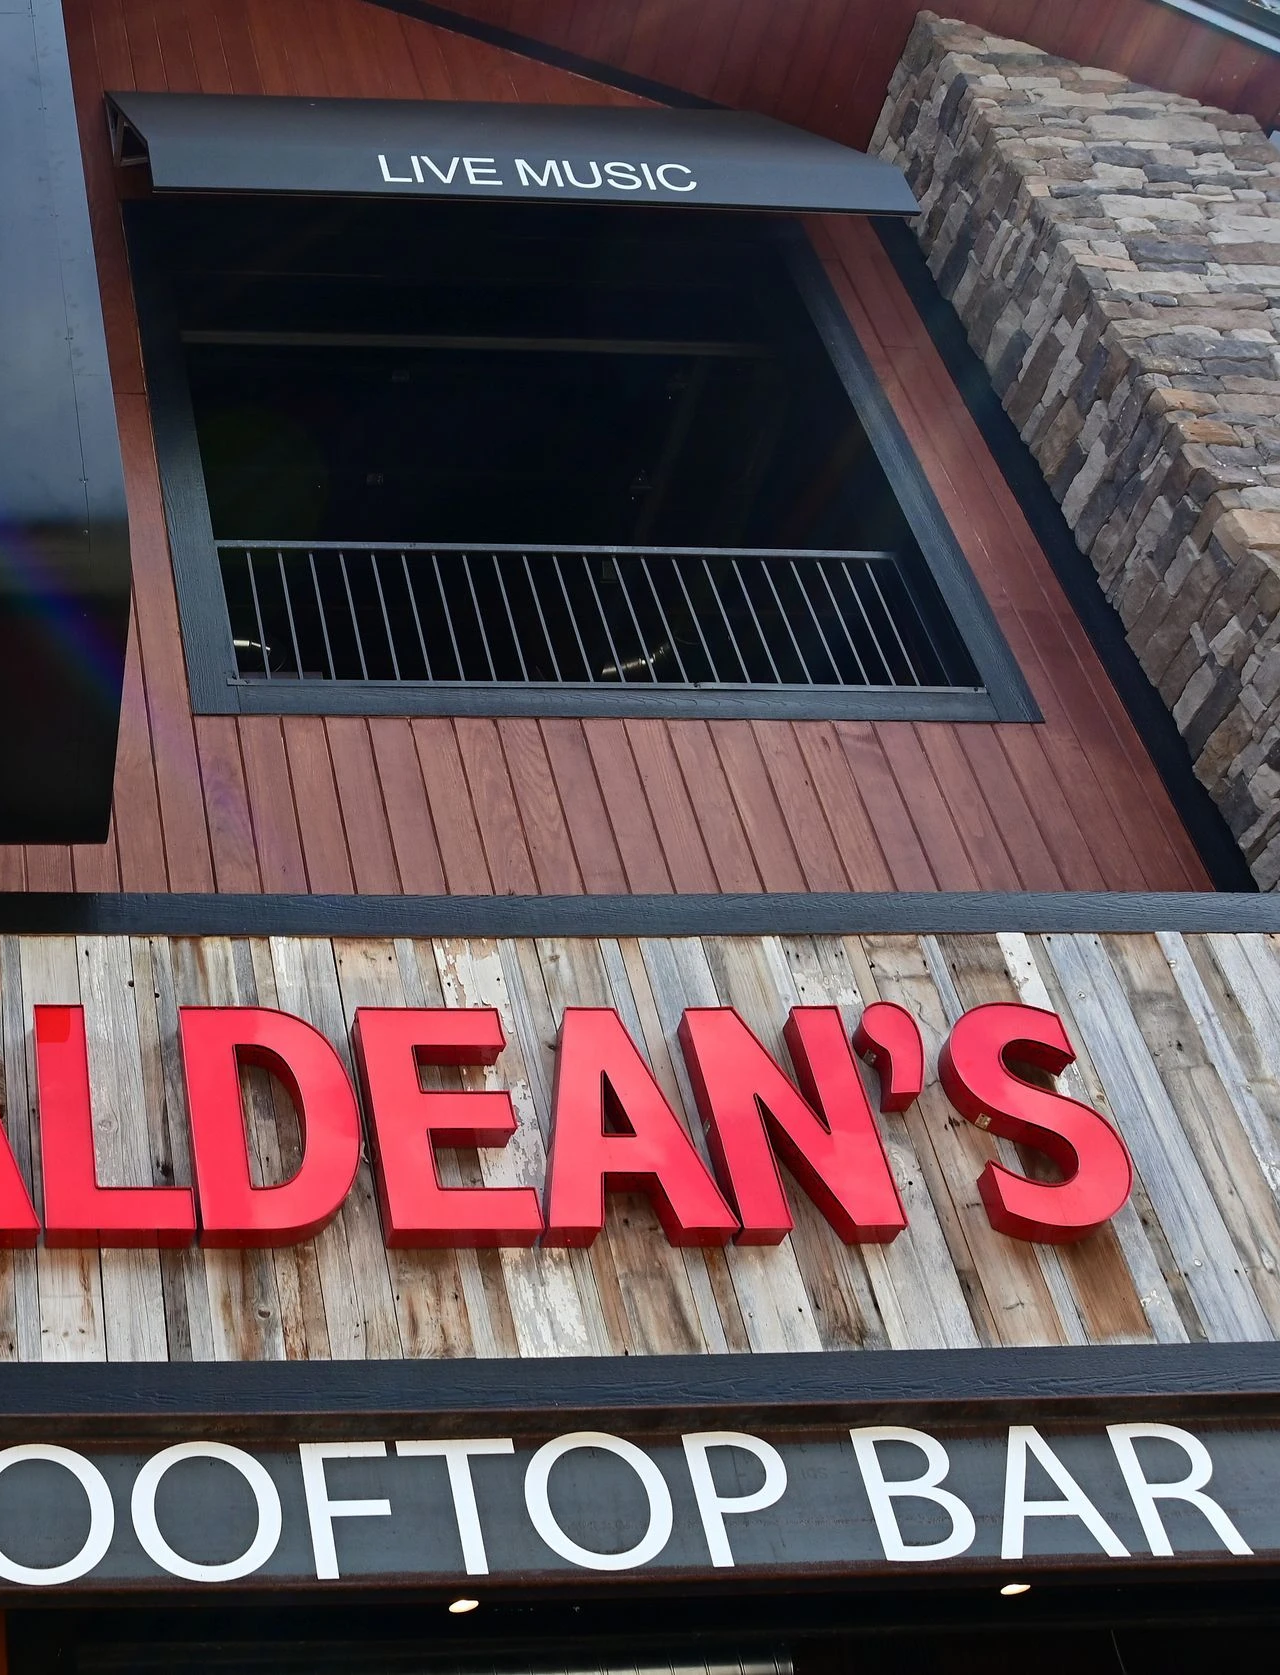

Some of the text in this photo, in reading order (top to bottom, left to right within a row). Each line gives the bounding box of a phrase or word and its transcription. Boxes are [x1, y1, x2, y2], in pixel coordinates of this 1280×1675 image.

[377, 154, 697, 192] LIVE MUSIC
[850, 1422, 1255, 1562] BAR
